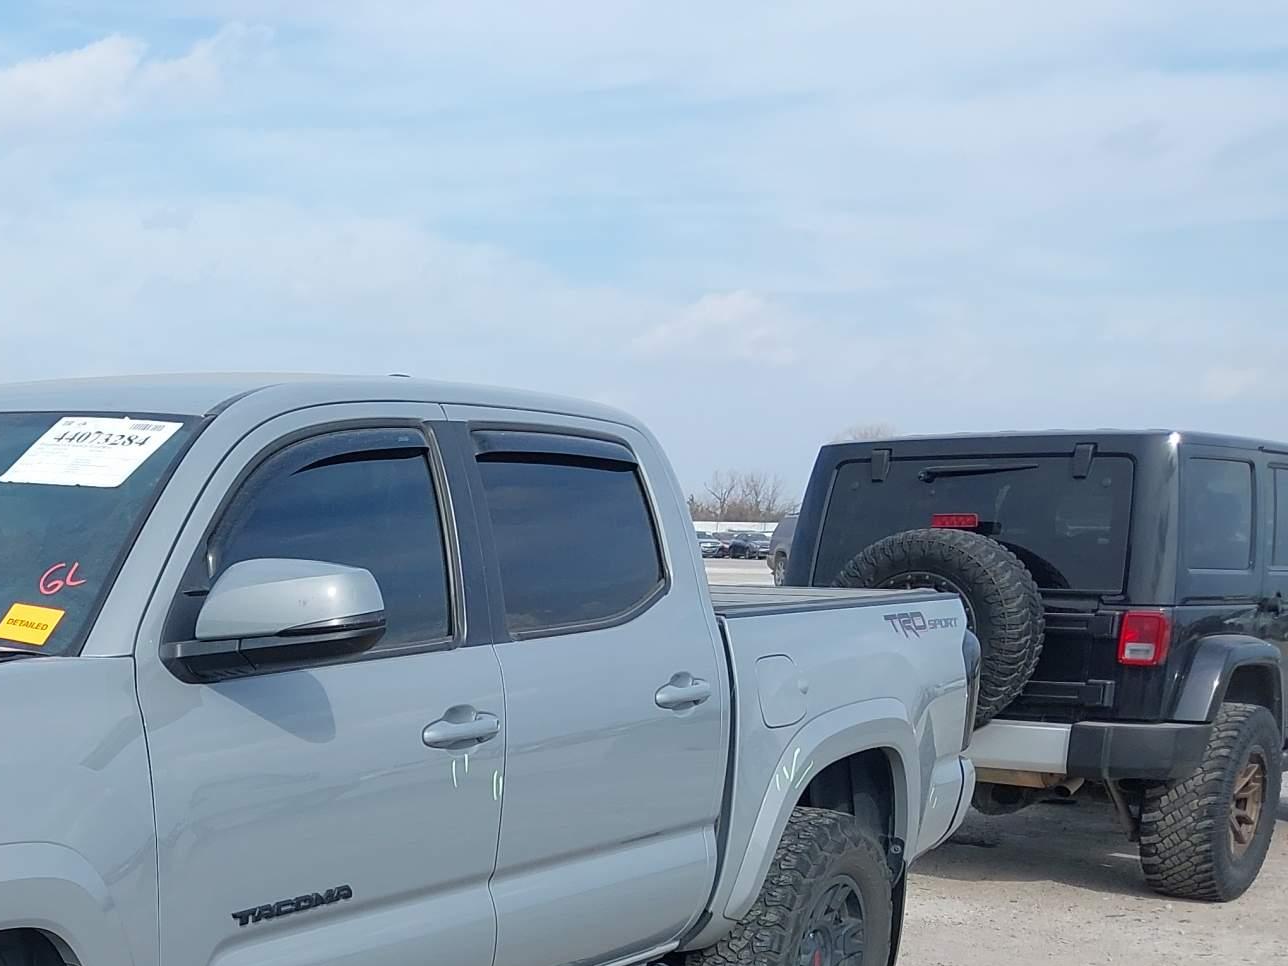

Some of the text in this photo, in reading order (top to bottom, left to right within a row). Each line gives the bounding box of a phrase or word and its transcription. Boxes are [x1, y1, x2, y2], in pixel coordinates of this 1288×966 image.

[53, 430, 152, 447] 44073284
[6, 617, 50, 632] DETAILED
[883, 611, 958, 638] TRD SPORT
[231, 884, 353, 926] TACOMA
